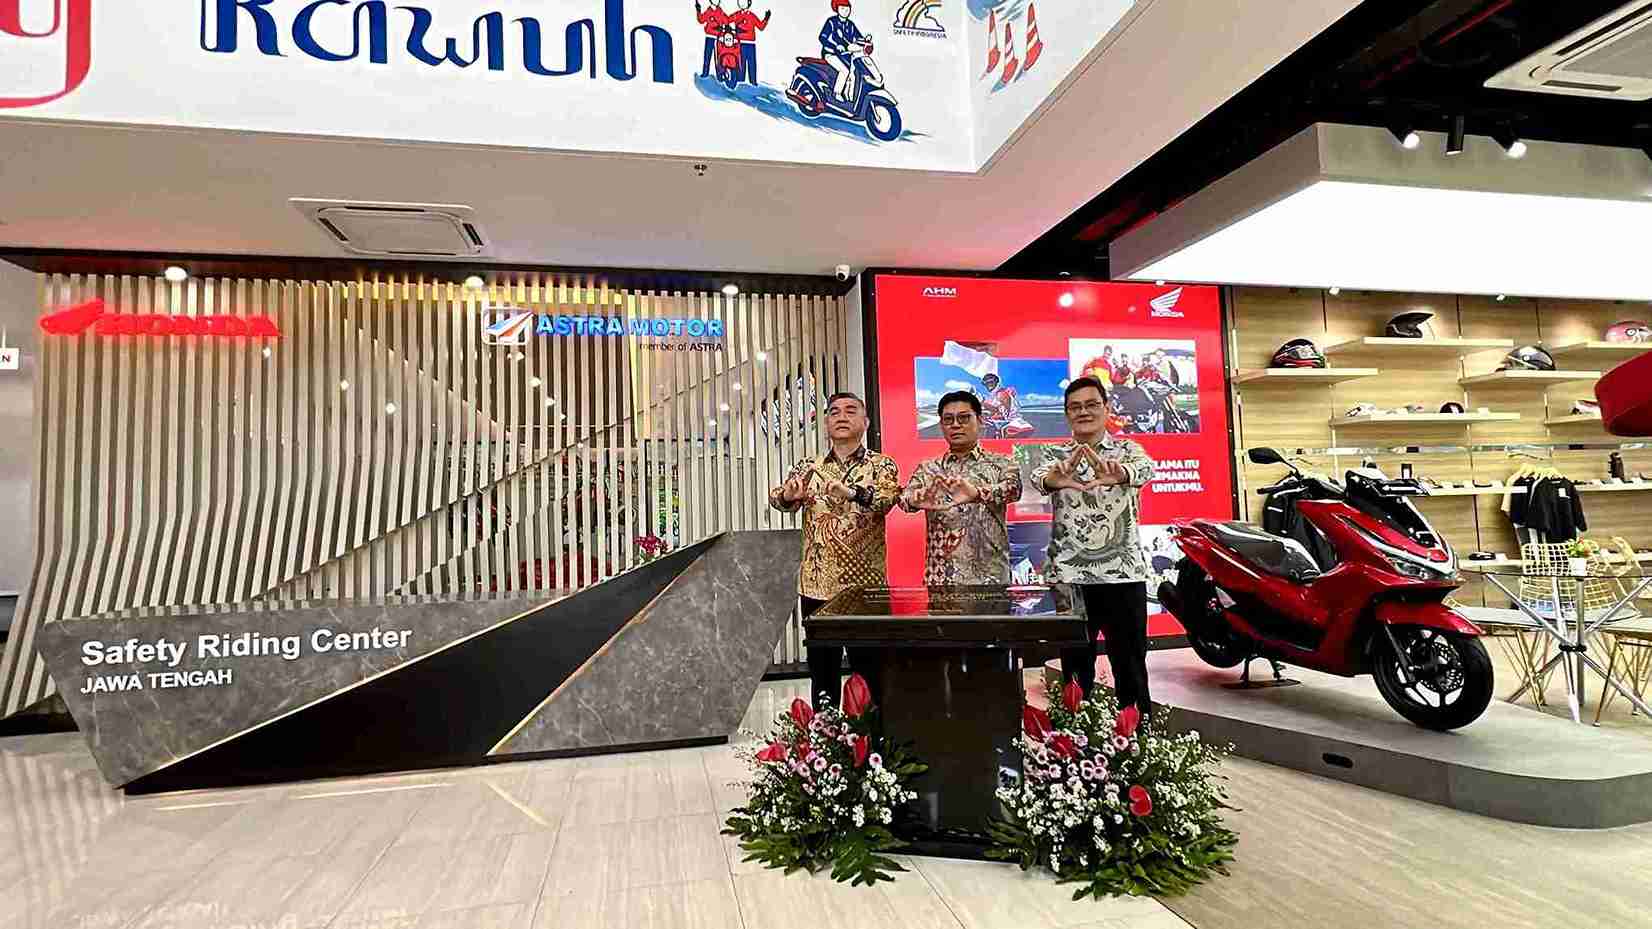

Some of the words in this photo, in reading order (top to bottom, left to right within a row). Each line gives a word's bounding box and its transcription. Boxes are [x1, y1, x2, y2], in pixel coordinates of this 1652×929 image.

[536, 313, 624, 337] ASTRA
[629, 318, 724, 337] MOTOR
[639, 342, 673, 351] member
[677, 341, 688, 351] of
[690, 342, 722, 352] ASTRA
[1152, 460, 1183, 469] LAMA
[1184, 460, 1199, 469] ITU
[81, 639, 187, 667] Safety
[198, 632, 300, 659] Riding
[311, 627, 413, 652] Center
[81, 675, 143, 694] JAWA
[147, 668, 233, 689] TENGAH
